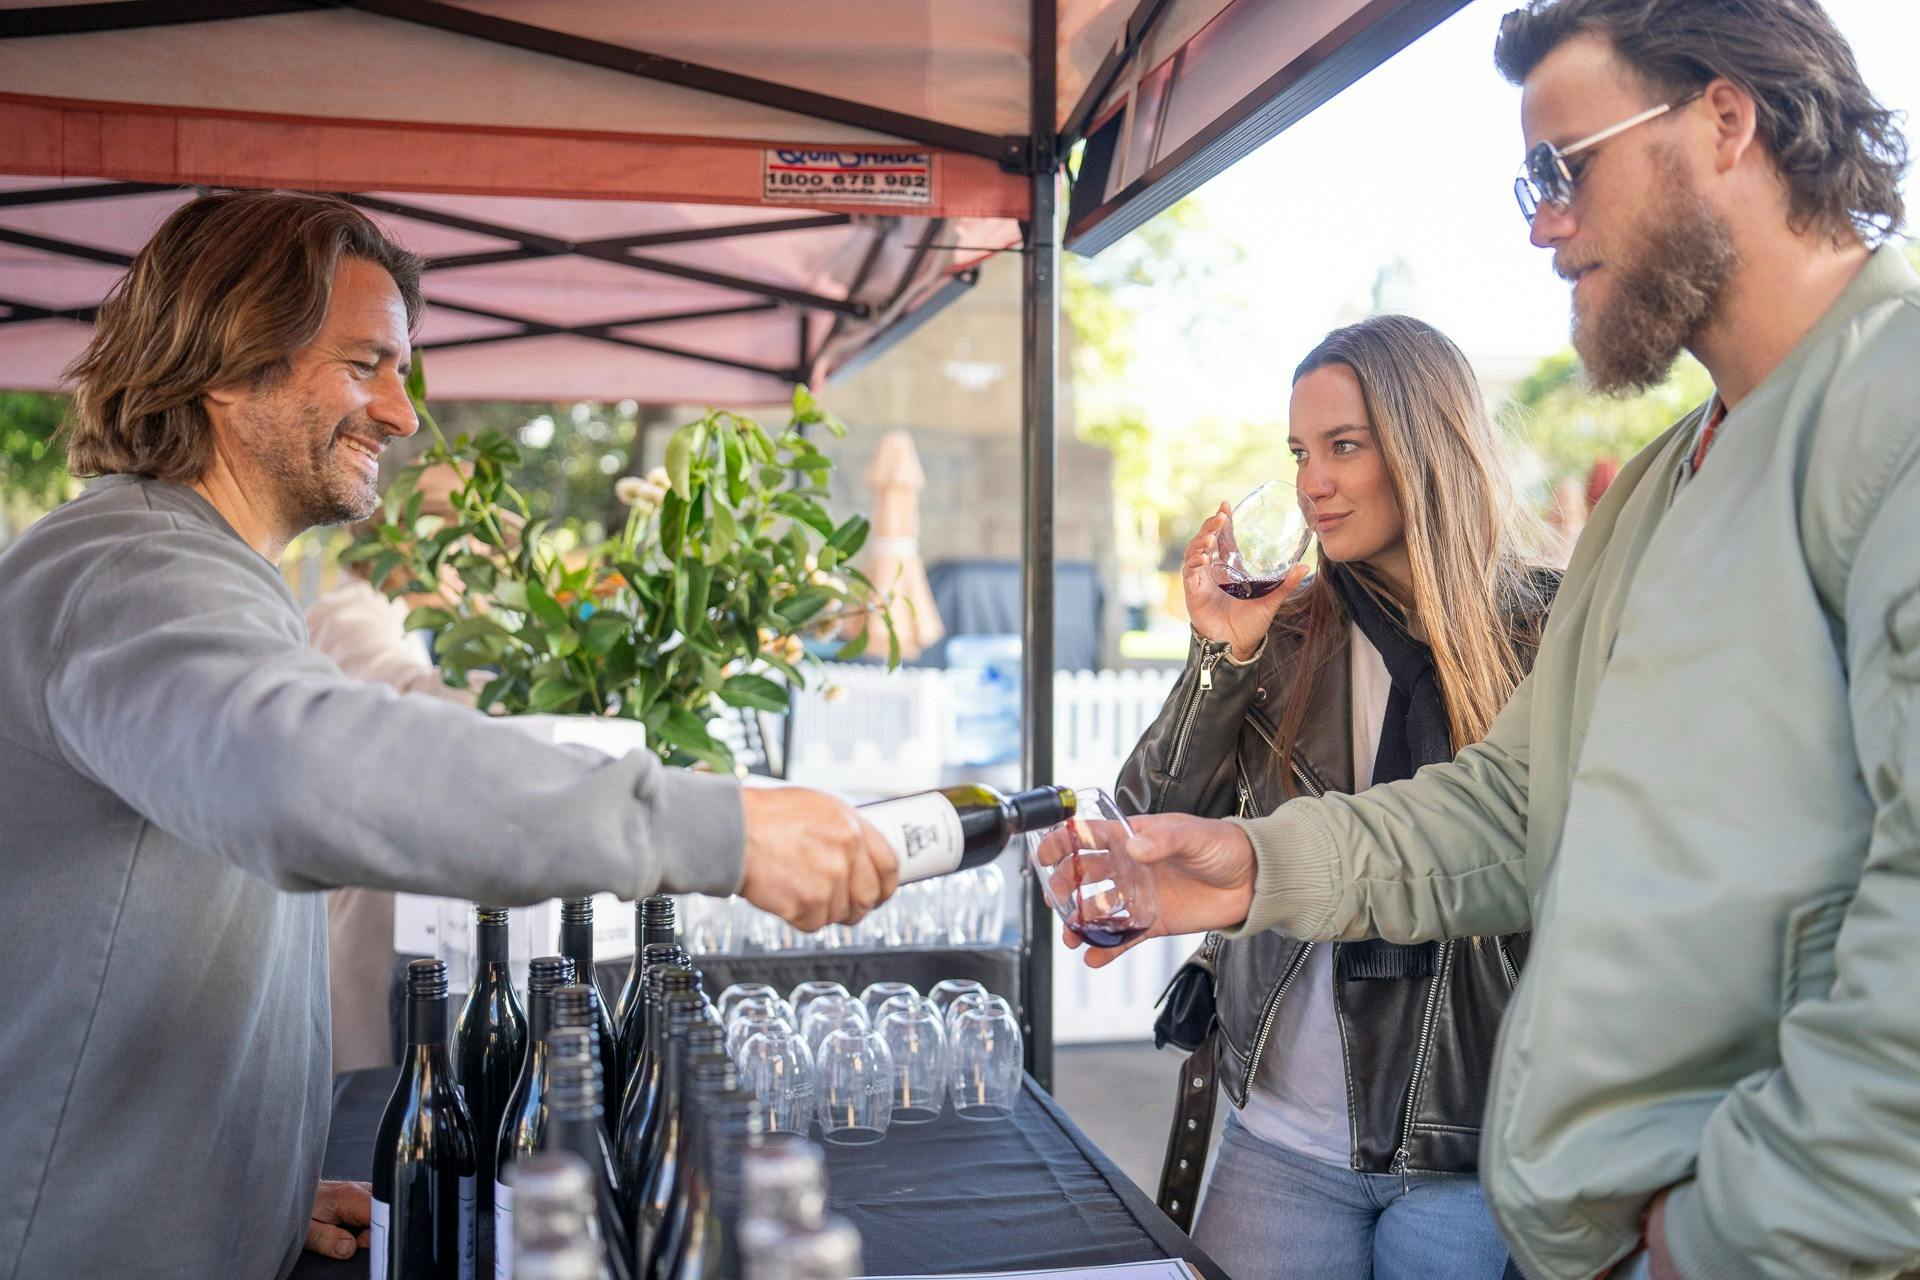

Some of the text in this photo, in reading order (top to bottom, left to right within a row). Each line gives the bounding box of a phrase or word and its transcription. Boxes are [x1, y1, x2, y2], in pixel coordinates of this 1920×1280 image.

[768, 173, 926, 187] 1800 678 982
